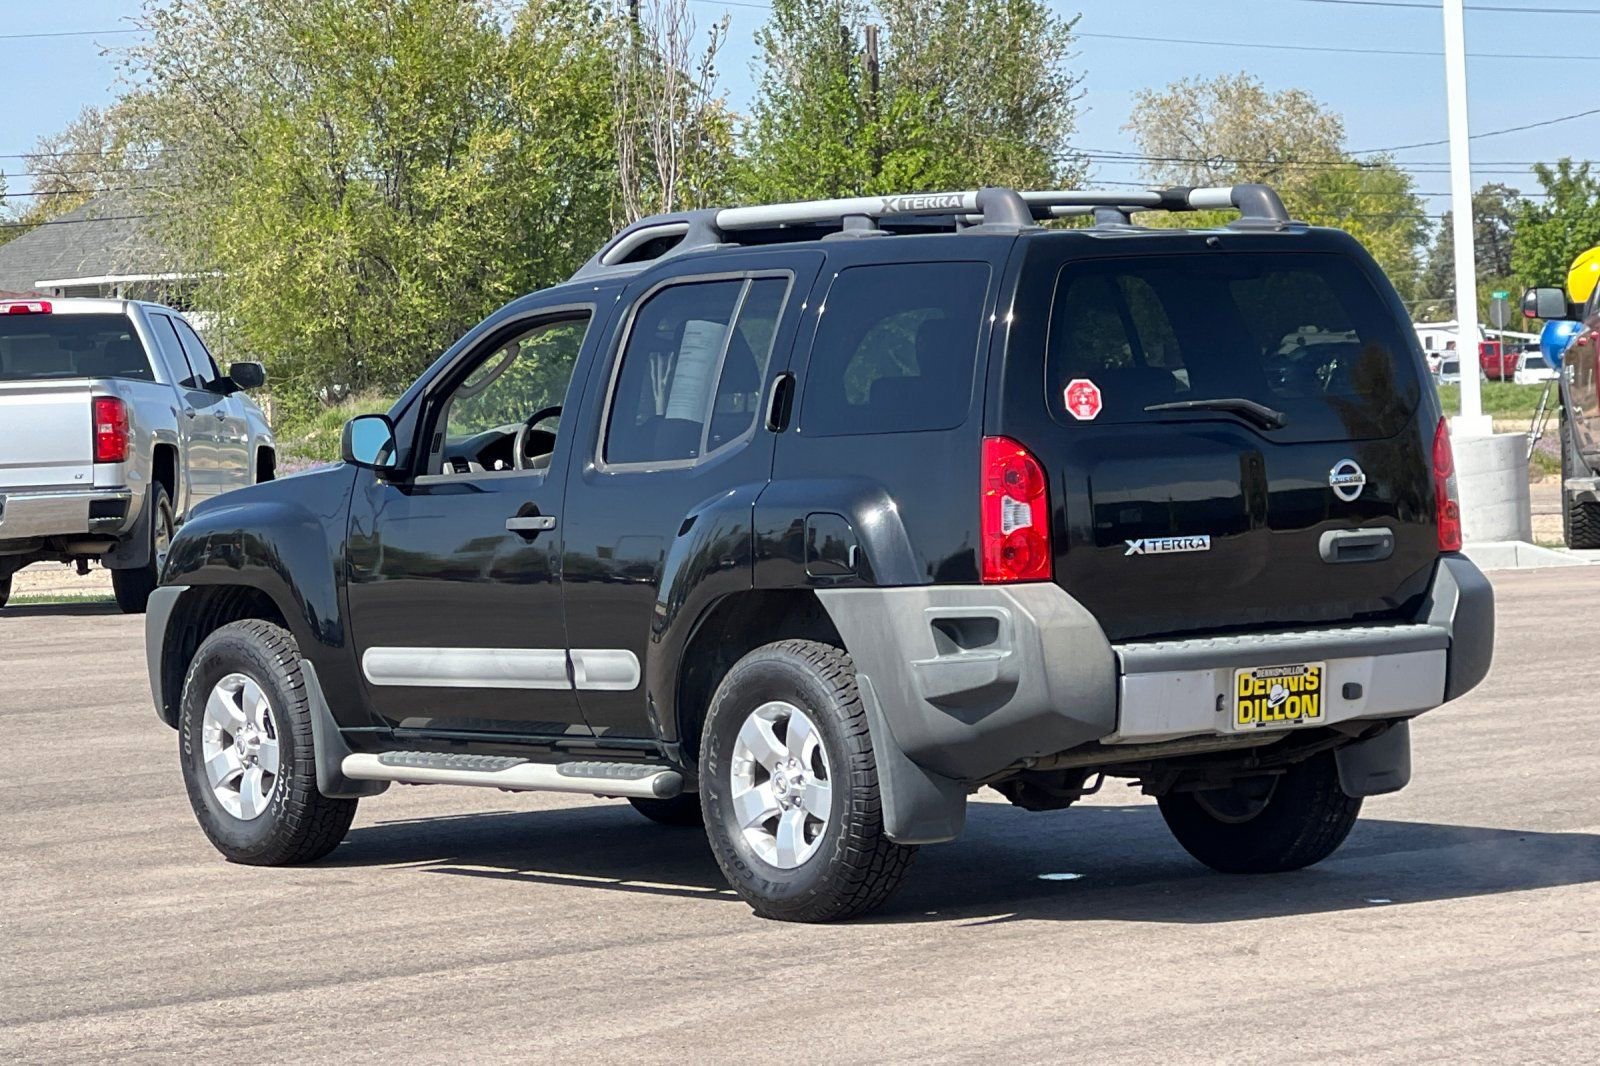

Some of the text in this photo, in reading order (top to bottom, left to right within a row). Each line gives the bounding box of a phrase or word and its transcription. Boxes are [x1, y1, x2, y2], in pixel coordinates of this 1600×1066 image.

[881, 193, 961, 213] XTERRA
[1125, 536, 1208, 556] XTERRA
[1239, 694, 1319, 725] DILLON
